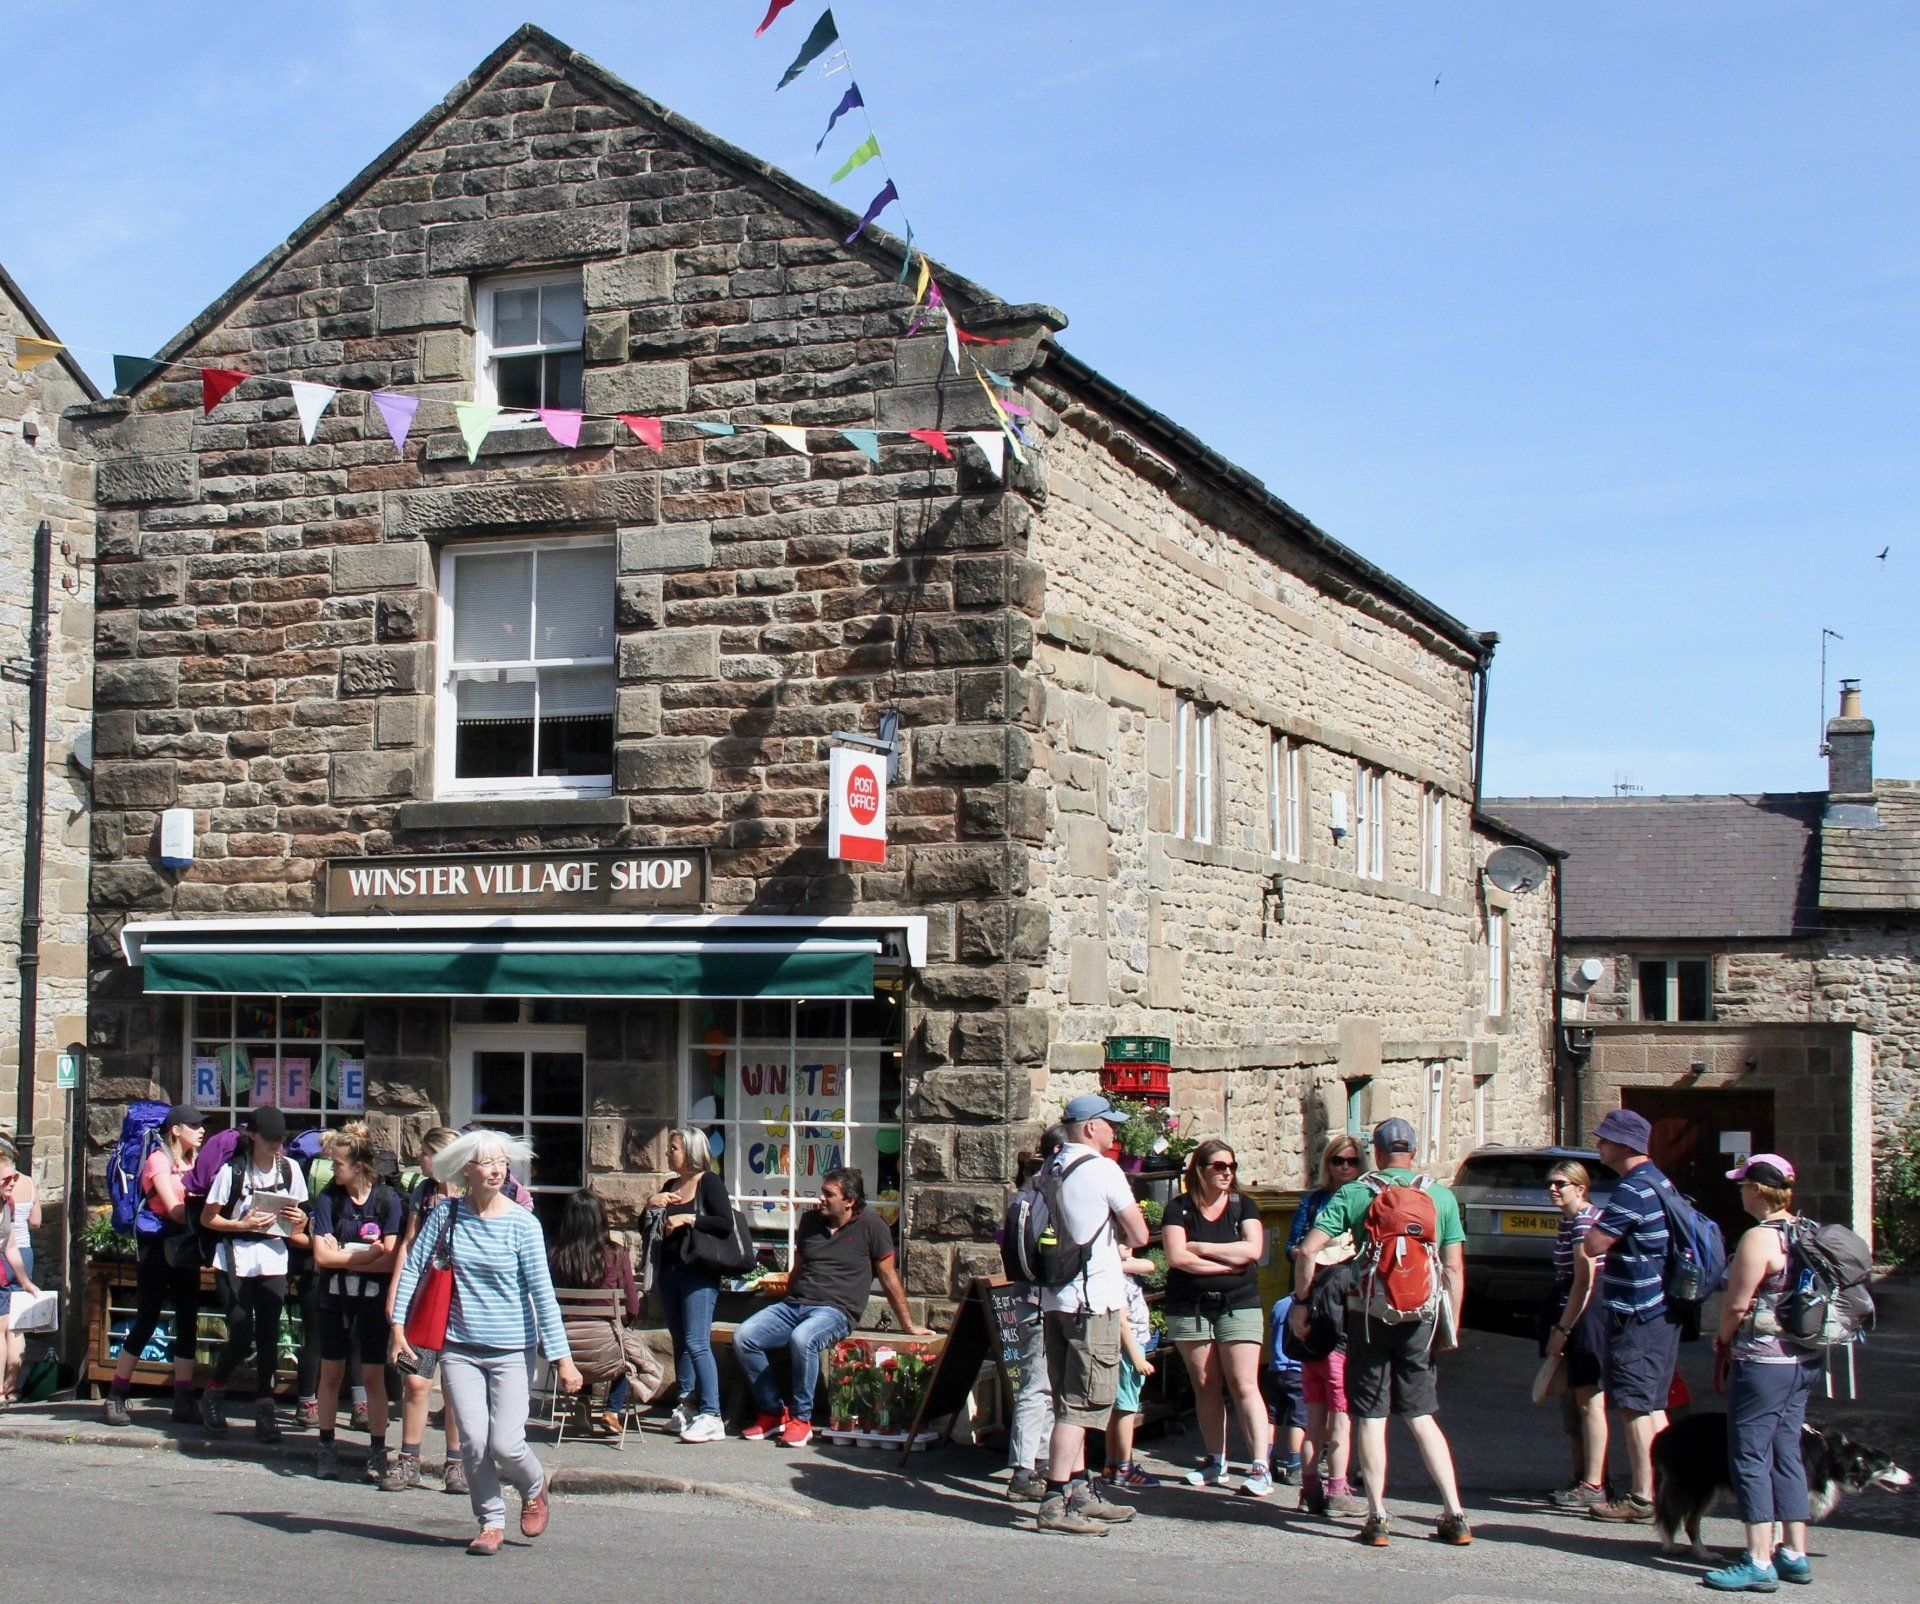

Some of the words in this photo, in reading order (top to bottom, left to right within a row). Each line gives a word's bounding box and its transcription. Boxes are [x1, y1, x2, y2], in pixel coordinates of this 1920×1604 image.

[854, 776, 874, 793] POST
[850, 793, 876, 811] OFFICE
[348, 866, 469, 896] WINSTER
[473, 862, 599, 894] VILLAGE
[610, 859, 692, 890] SHOP
[749, 1143, 851, 1176] CARNIVA
